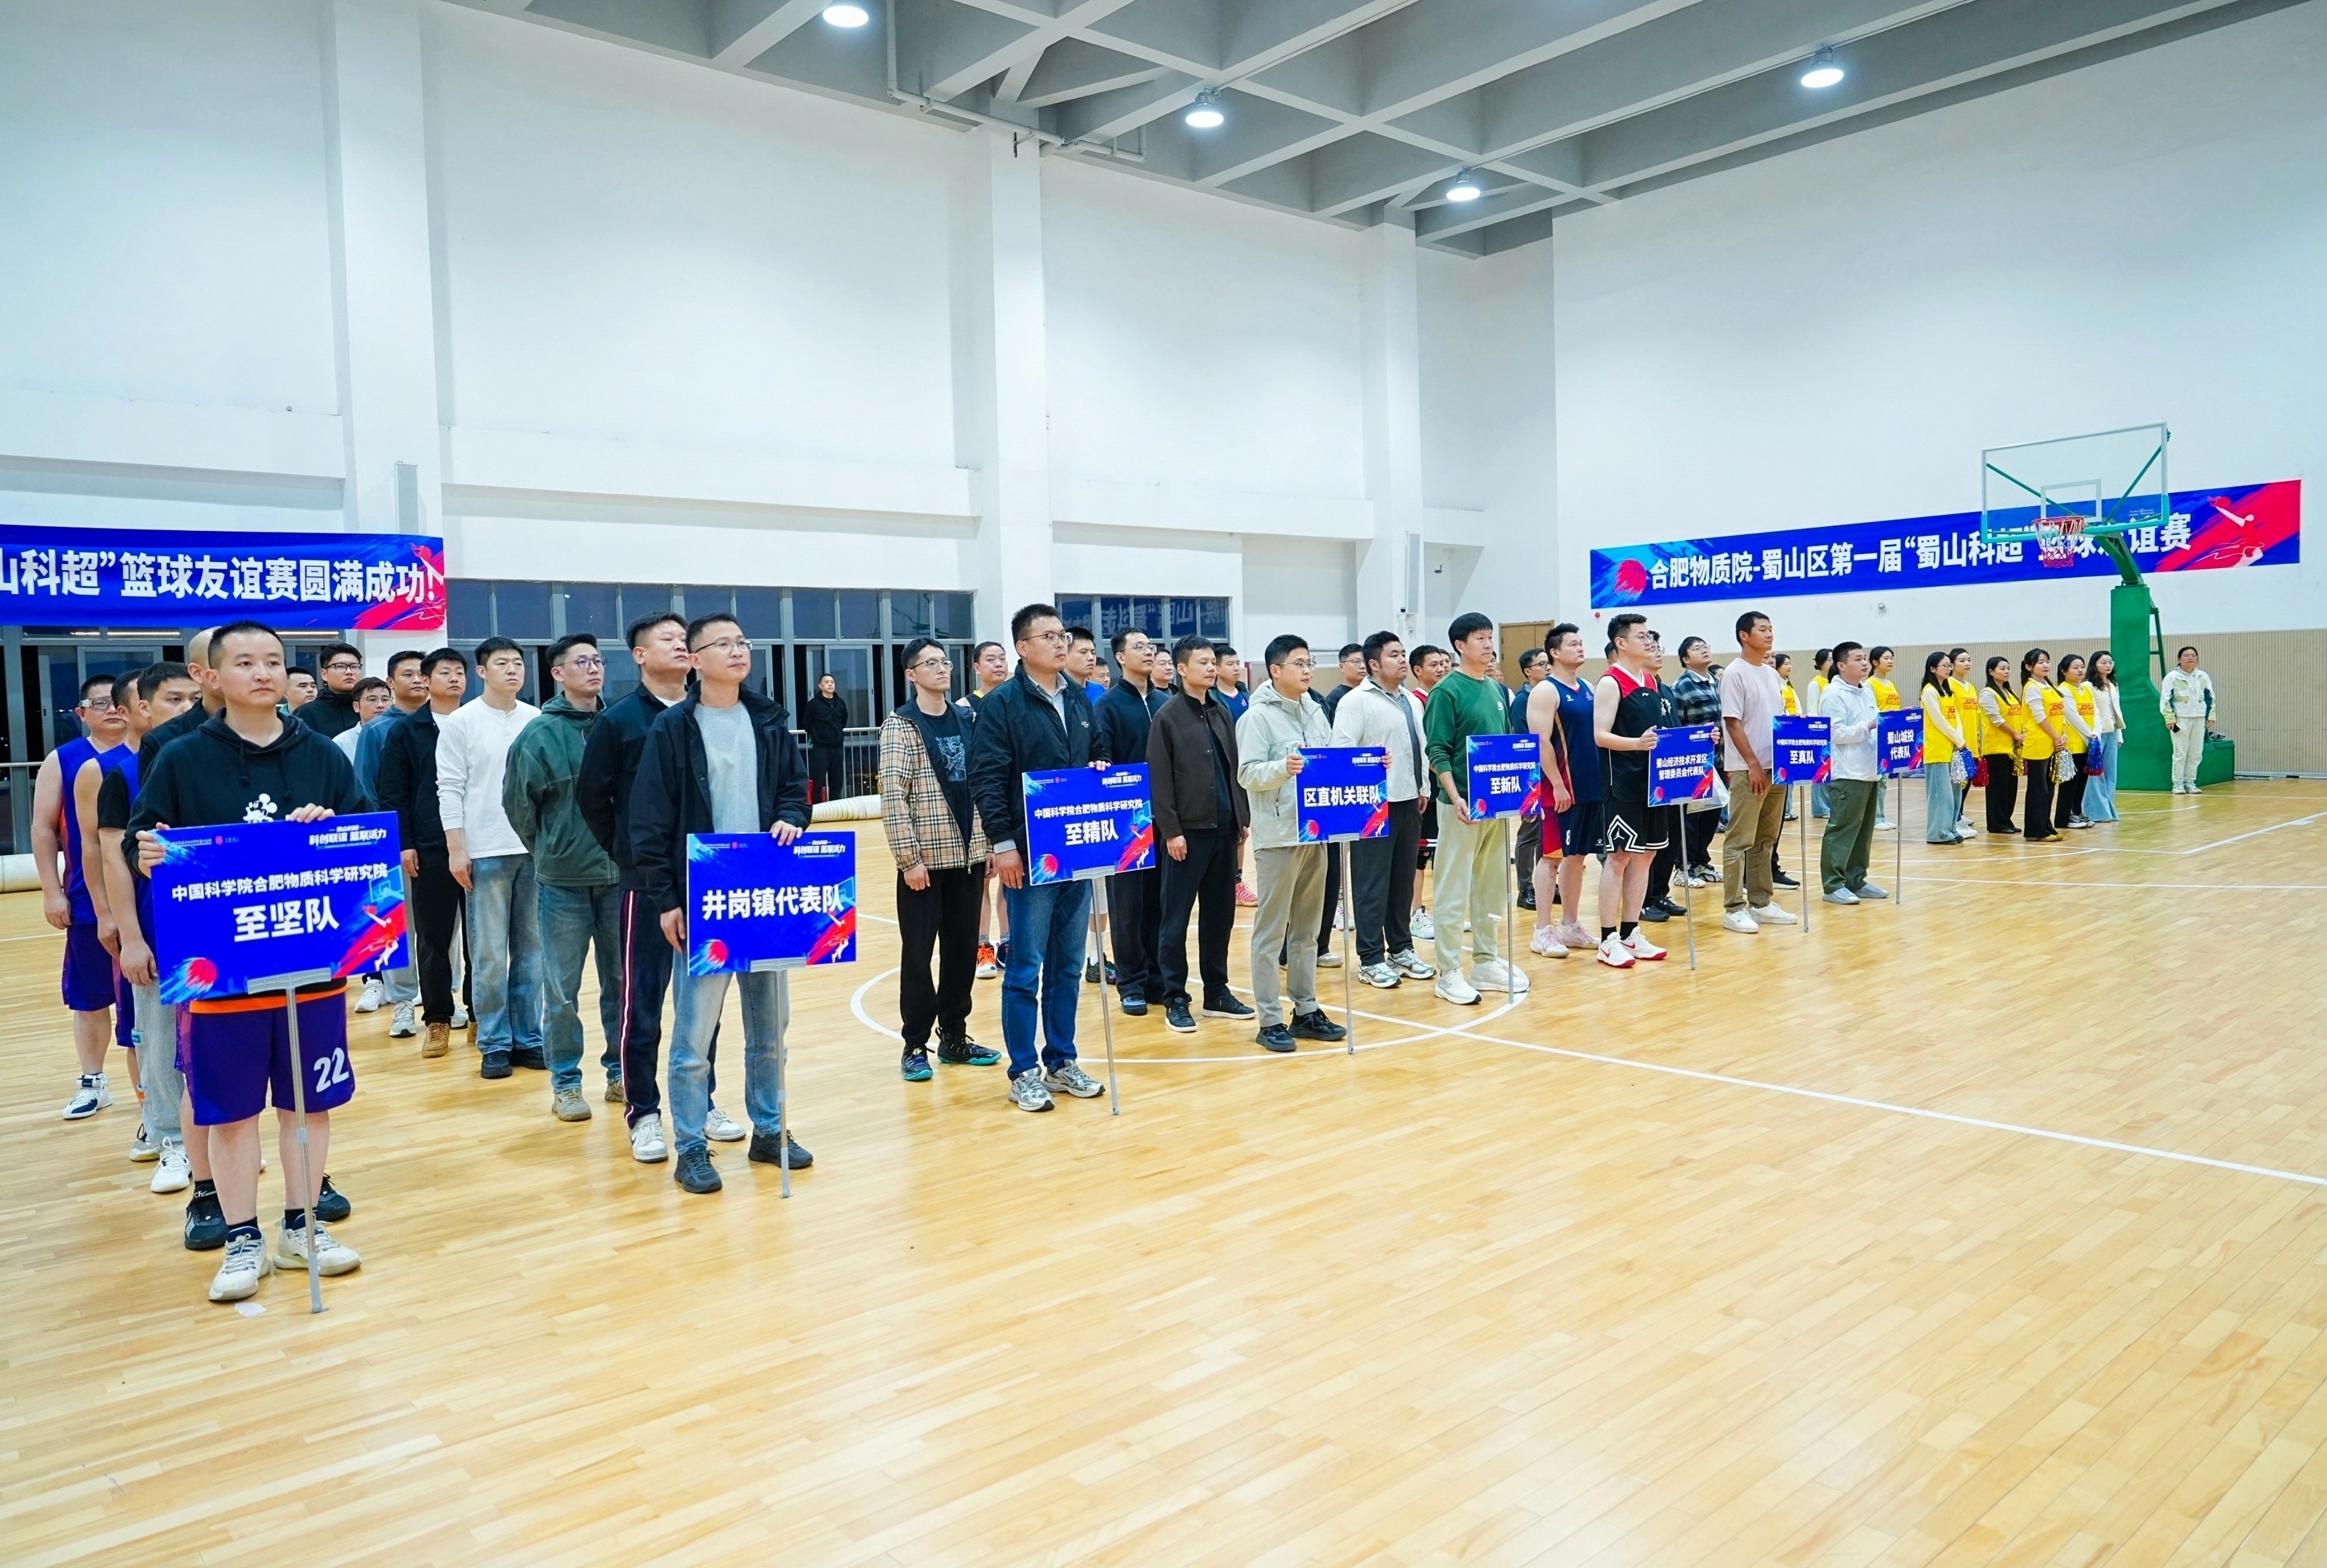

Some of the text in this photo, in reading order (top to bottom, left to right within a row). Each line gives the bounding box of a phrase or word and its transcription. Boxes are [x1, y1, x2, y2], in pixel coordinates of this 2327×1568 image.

[1650, 512, 2191, 590] 合肥物质院-蜀山区第一届“蜀山科超”篮球谊赛
[1887, 729, 1914, 744] 蜀山城投
[1656, 753, 1708, 768] 蜀山经济技术开发区
[1790, 750, 1815, 764] 至真队
[1890, 745, 1911, 761] 代表队
[1474, 761, 1536, 773] 中国科学院合肥物质科学研究院
[1659, 765, 1703, 781] 管理委员会代表队
[1490, 775, 1521, 794] 至新队
[1304, 785, 1382, 807] 区直机关联队
[1034, 799, 1143, 820] 中国科学院合肥物质科学研究院
[1065, 818, 1119, 846] 至精队
[172, 863, 389, 902] 中国科学院合肥物质科学研究院
[702, 884, 845, 921] 井岗镇代表队
[233, 895, 340, 943] 至坚队
[314, 1047, 349, 1093] 22
